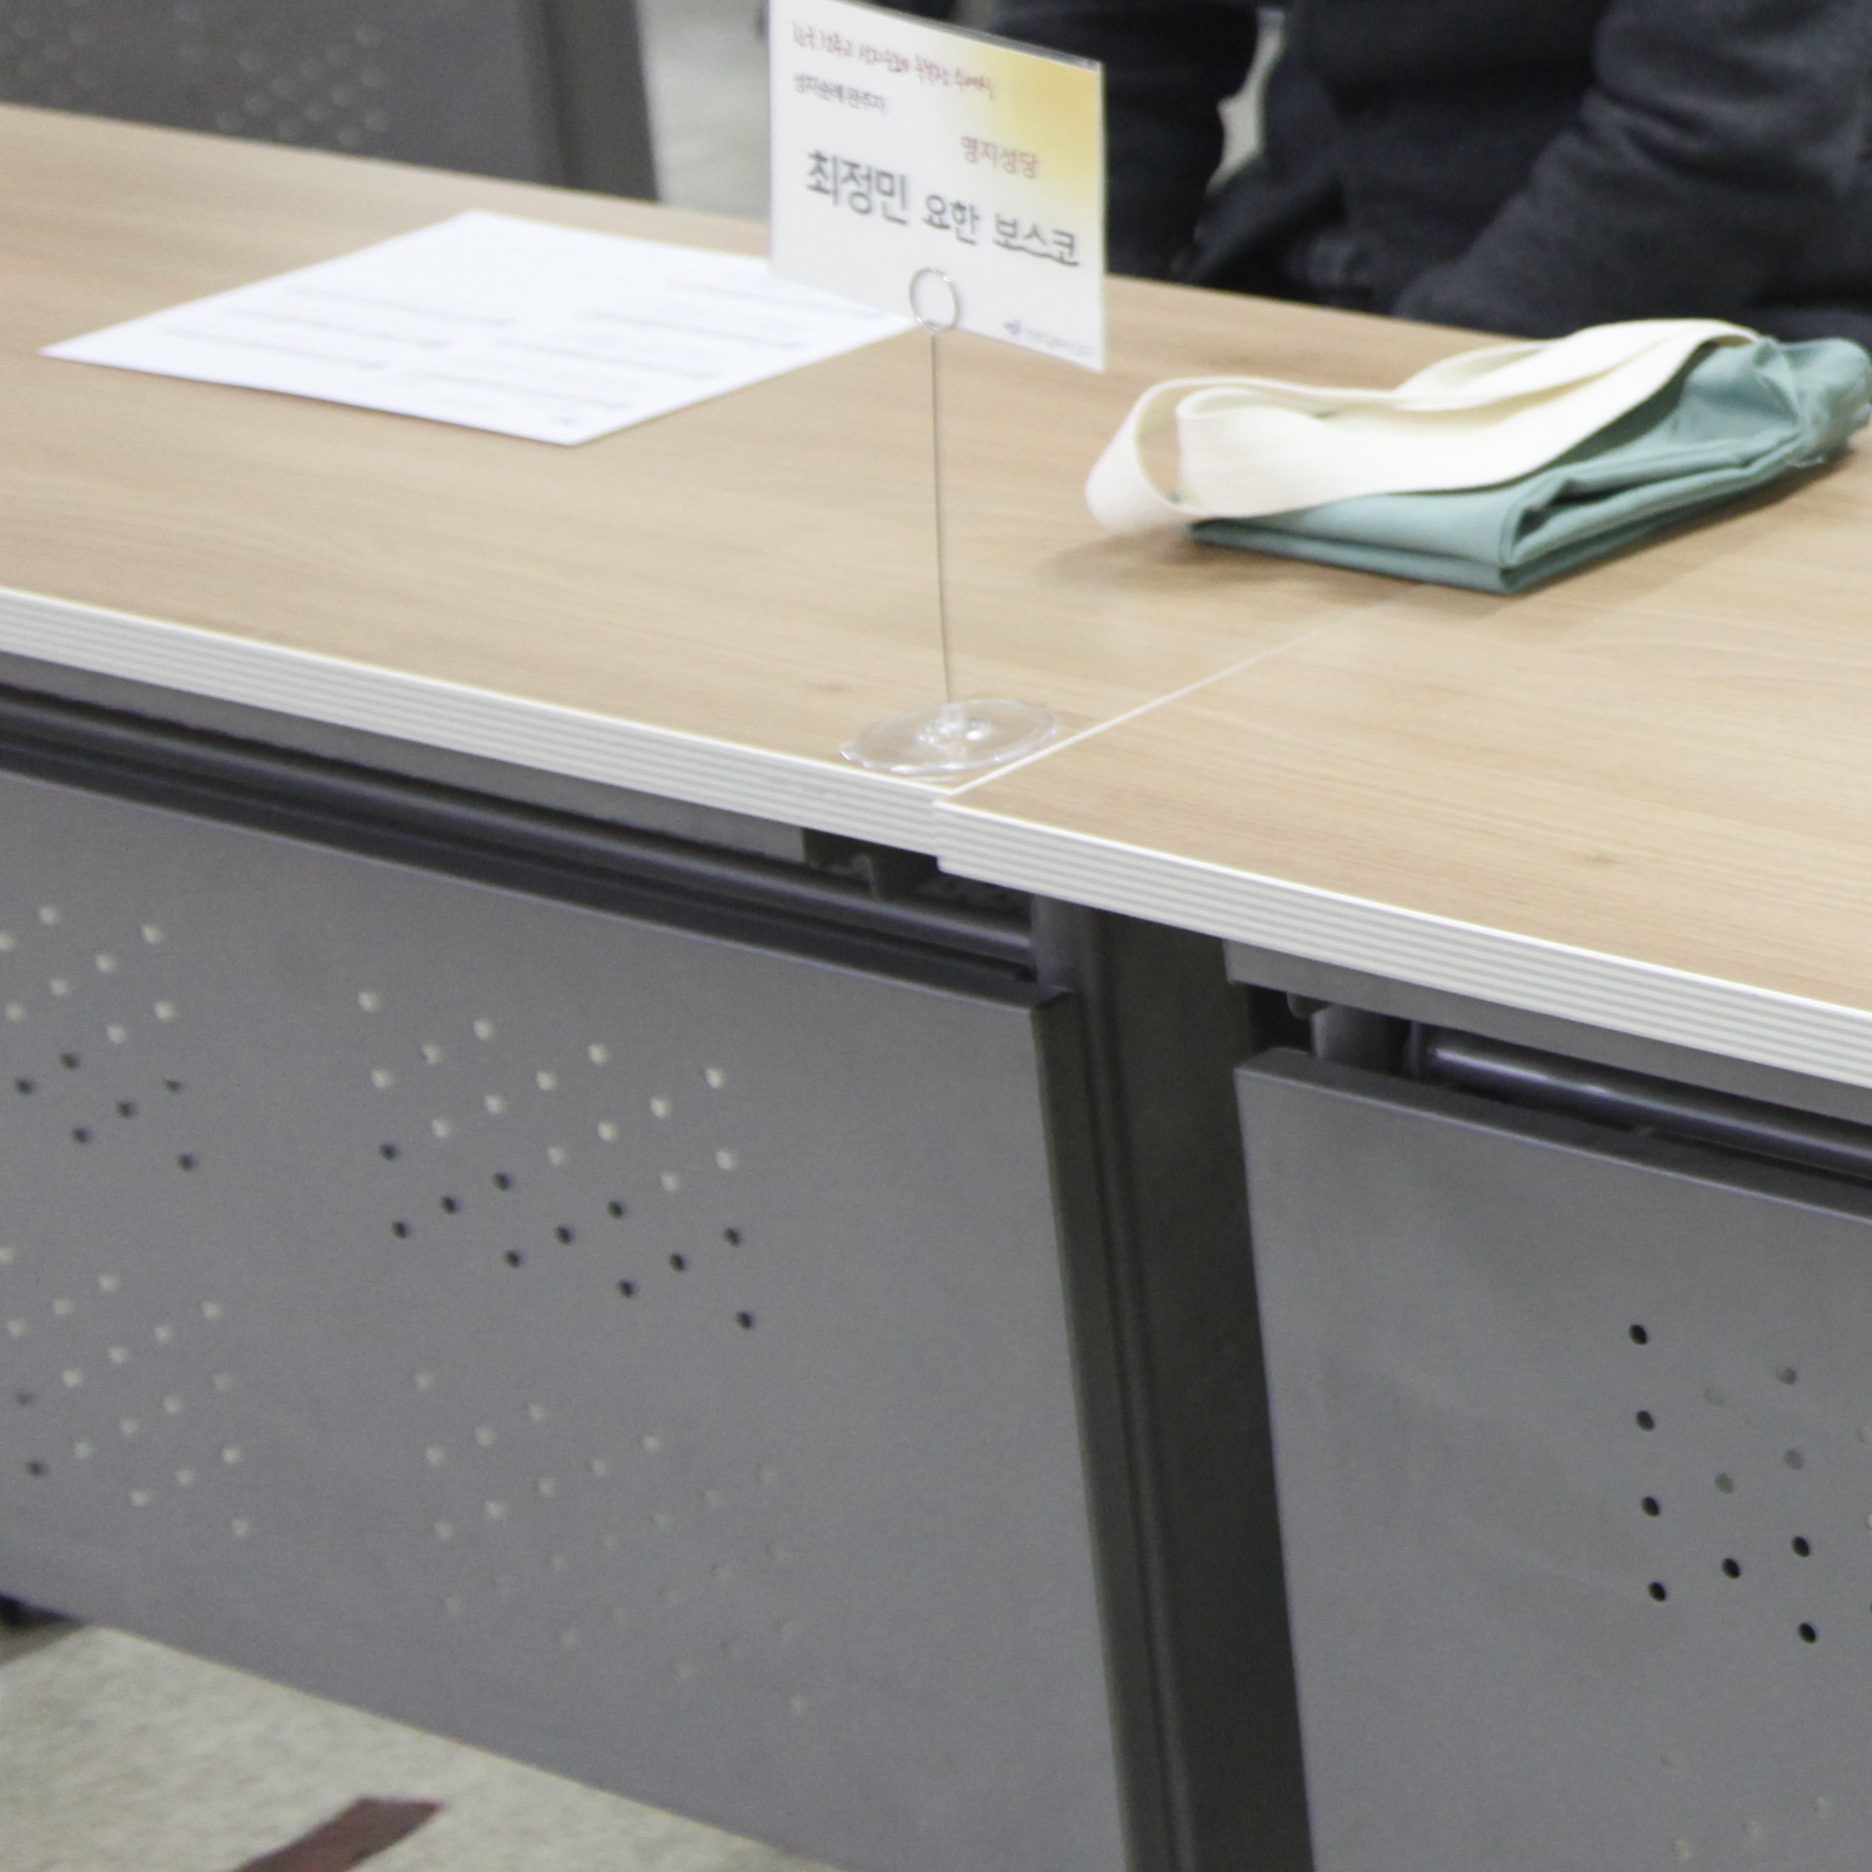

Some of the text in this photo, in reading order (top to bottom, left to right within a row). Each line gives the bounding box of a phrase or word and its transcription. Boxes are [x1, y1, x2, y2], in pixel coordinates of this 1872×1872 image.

[961, 135, 1039, 179] 명지성당
[805, 149, 1079, 267] 최정민 요한 보스코
